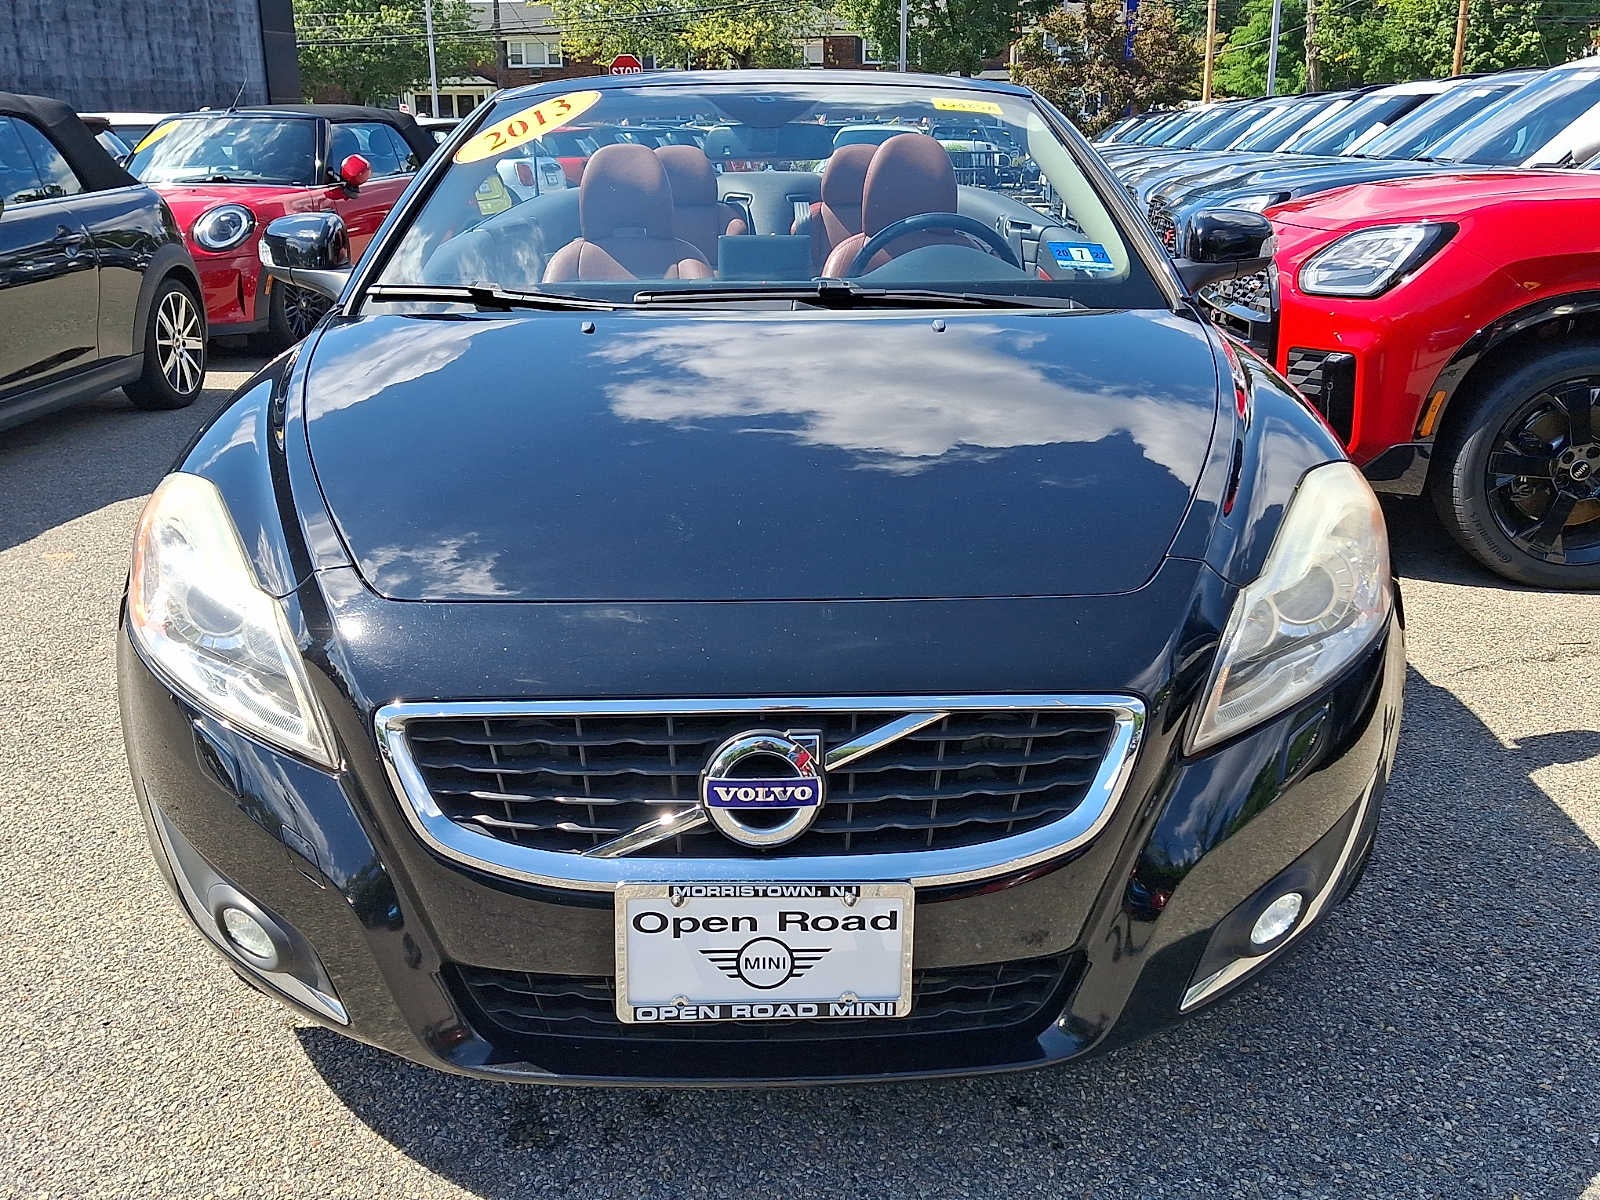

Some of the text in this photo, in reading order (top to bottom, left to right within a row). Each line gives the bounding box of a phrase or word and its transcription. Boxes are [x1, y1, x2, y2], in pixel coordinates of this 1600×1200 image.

[612, 67, 640, 75] STOP
[484, 99, 571, 151] 2013
[1056, 249, 1069, 257] 20
[1075, 249, 1085, 260] 7
[1574, 463, 1589, 478] MINI
[713, 786, 813, 802] VOLVO
[673, 885, 857, 897] MORRISTOWN, NJ
[632, 910, 898, 939] Open Road
[744, 956, 787, 971] MINI
[636, 1002, 893, 1021] OPEN ROAD MINI
